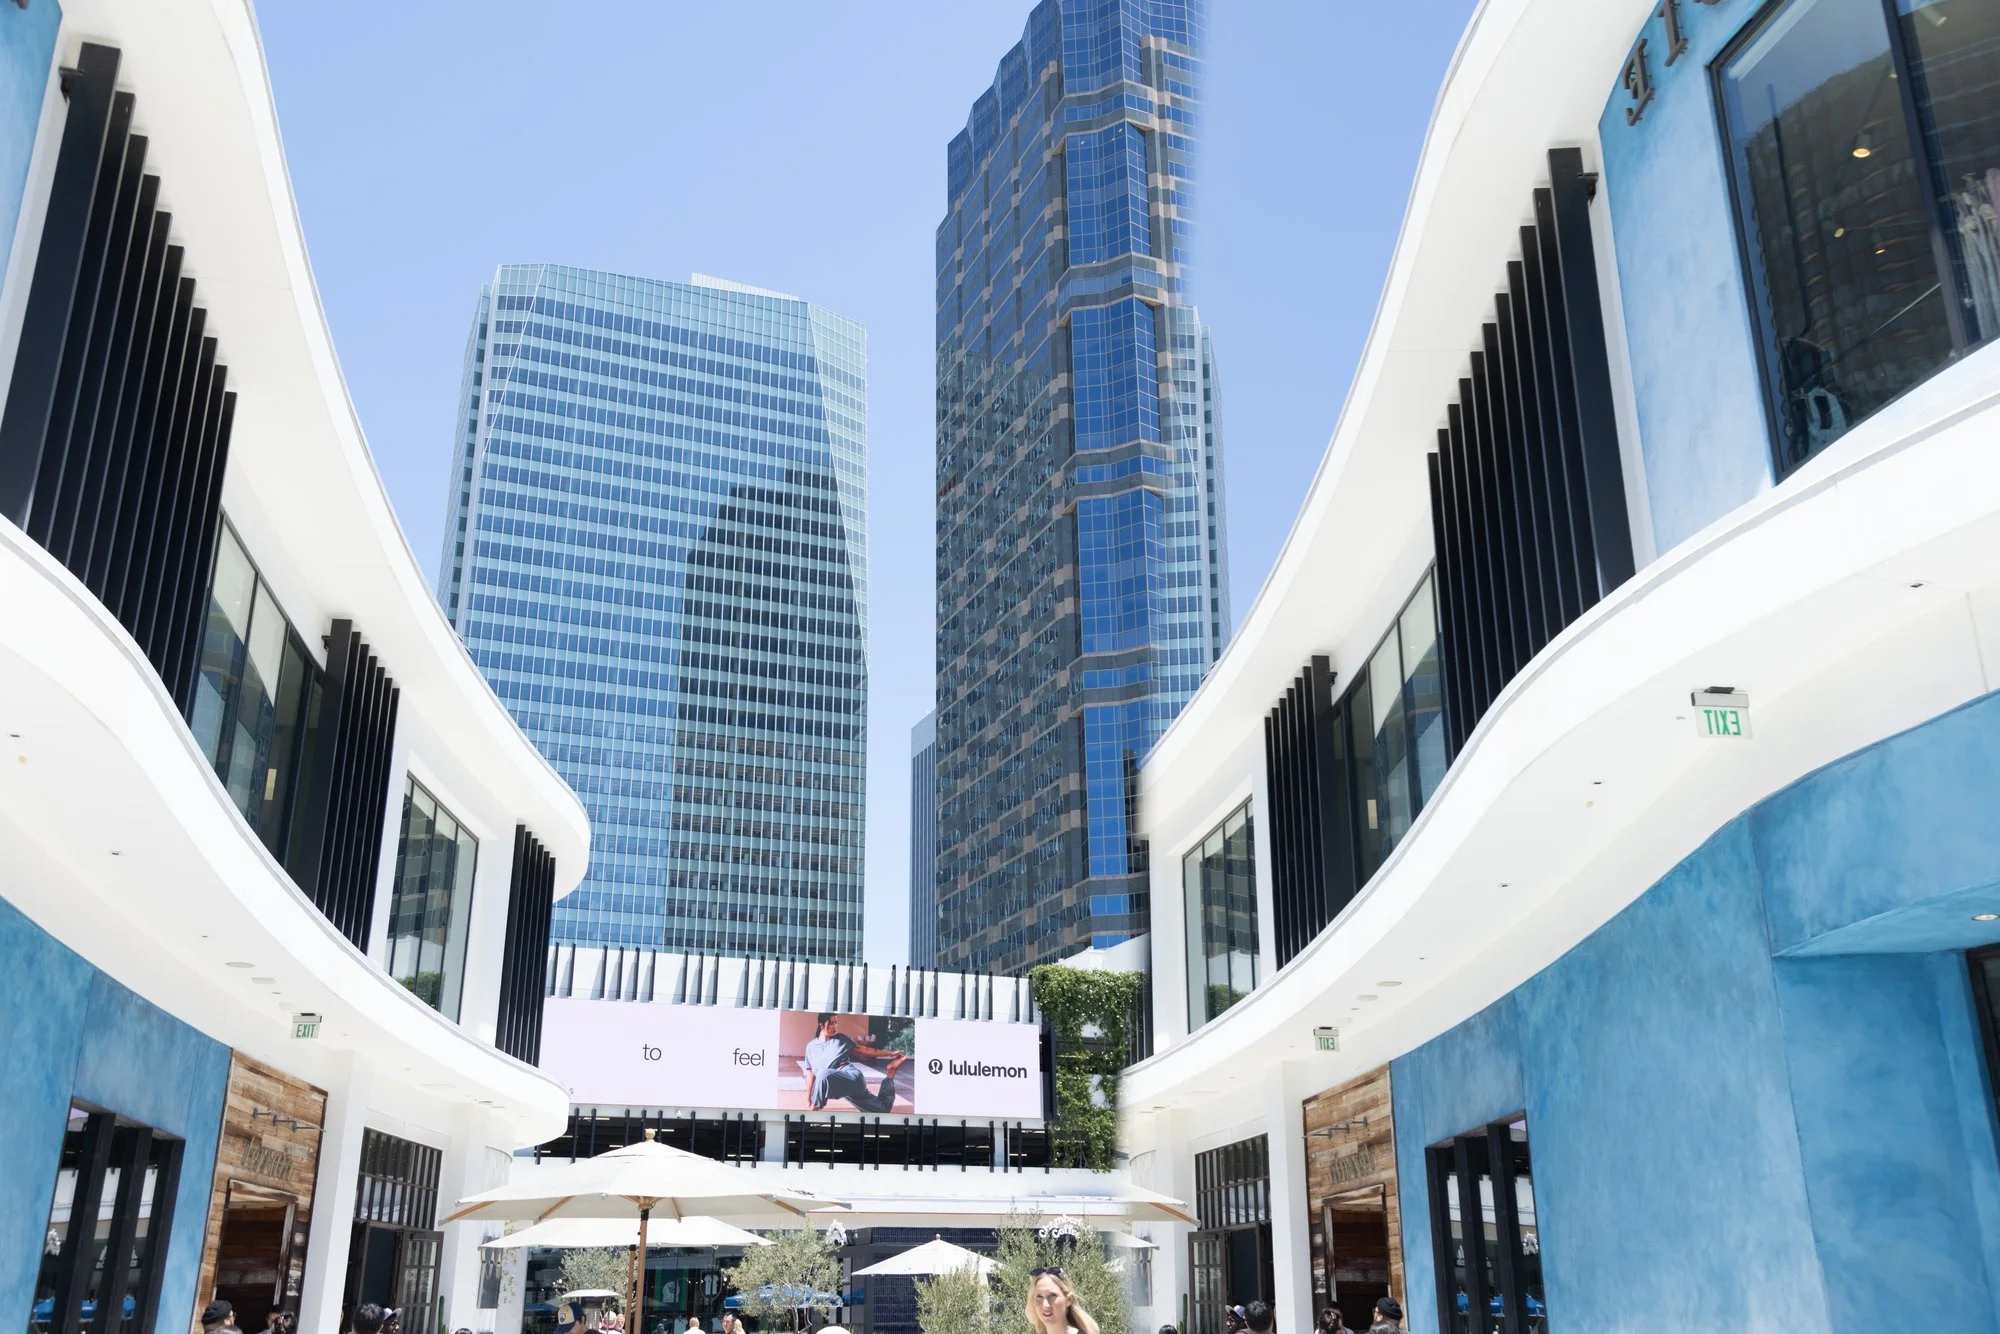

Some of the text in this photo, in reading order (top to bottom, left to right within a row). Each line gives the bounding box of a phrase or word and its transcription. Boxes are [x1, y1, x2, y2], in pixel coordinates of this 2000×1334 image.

[296, 1023, 317, 1038] EXIT
[642, 1043, 765, 1067] to feel
[949, 1059, 1028, 1079] lululemon
